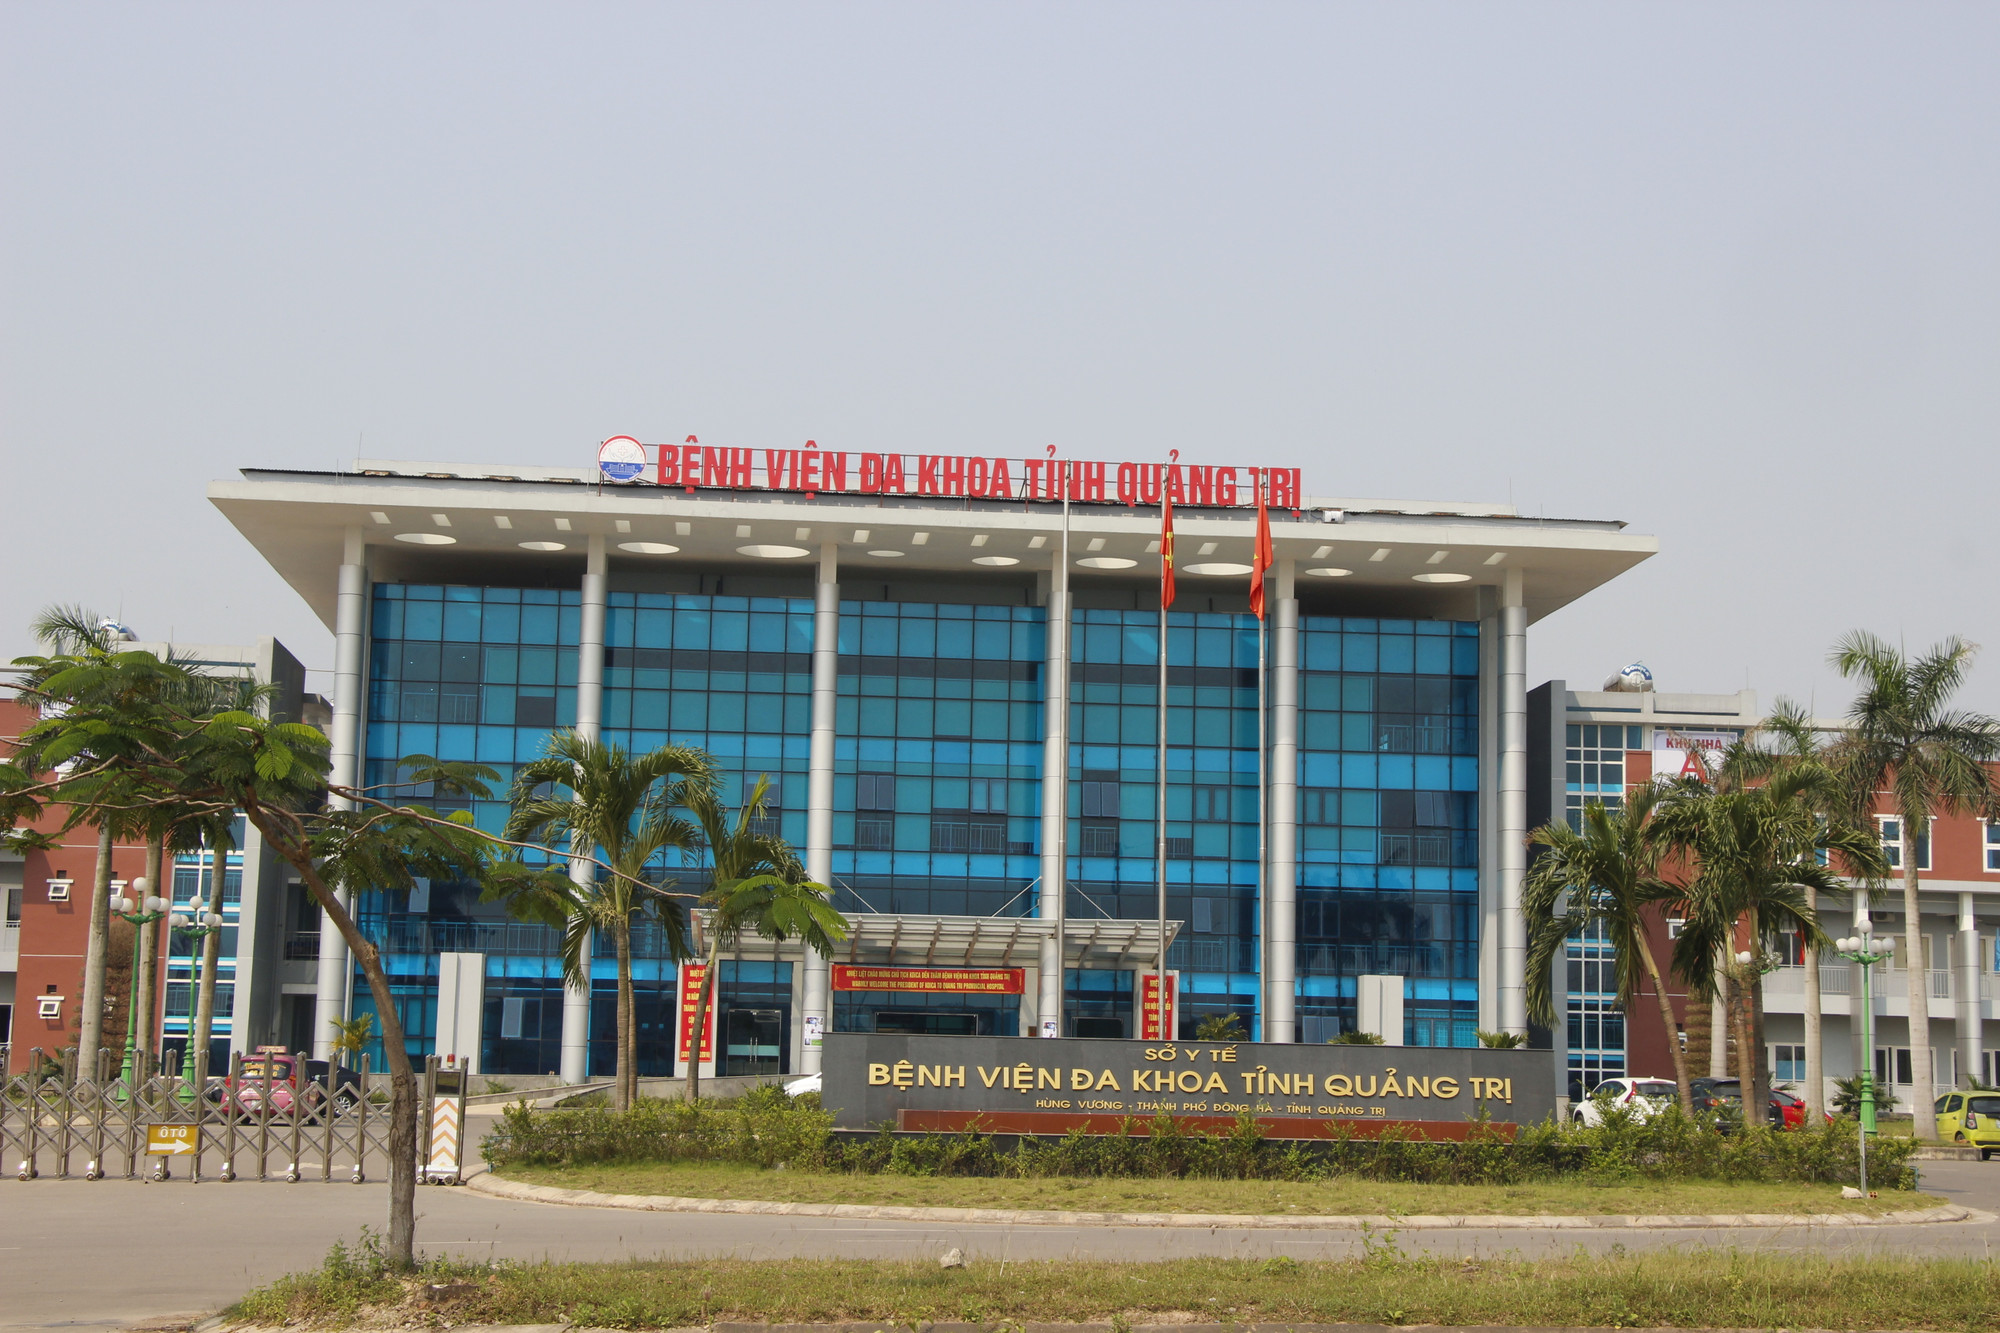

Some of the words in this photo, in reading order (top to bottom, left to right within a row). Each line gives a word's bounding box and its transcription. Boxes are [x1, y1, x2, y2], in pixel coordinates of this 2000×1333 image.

[658, 435, 752, 495] BỆNH
[766, 440, 848, 500] VIỆN
[859, 453, 906, 494] ĐA
[917, 455, 1013, 499] KHOA
[1025, 445, 1106, 503] TỈNH
[1118, 449, 1238, 508] QUẢNG
[1248, 467, 1302, 517] TRỊ
[1144, 1043, 1177, 1061] SỞ
[1184, 1049, 1200, 1061] Y
[1209, 1044, 1238, 1062] TẾ
[868, 1060, 965, 1091] BỆNH
[977, 1062, 1061, 1094] VIỆN
[1070, 1068, 1121, 1092] ĐA
[1132, 1070, 1229, 1094] KHOA
[1241, 1065, 1314, 1096] TỈNH
[1324, 1068, 1460, 1099] QUẢNG
[1468, 1077, 1512, 1104] TRỊ
[1036, 1097, 1071, 1109] HÙNG
[1078, 1099, 1123, 1110] VƯƠNG
[1137, 1099, 1177, 1110] THÀNH
[1183, 1100, 1207, 1112] PHỐ
[1213, 1102, 1249, 1112] ĐÔNG
[1256, 1101, 1273, 1113] HÀ
[1286, 1102, 1311, 1114] TỈNH
[1317, 1103, 1364, 1115] QUẢNG
[1370, 1106, 1386, 1117] TRỊ
